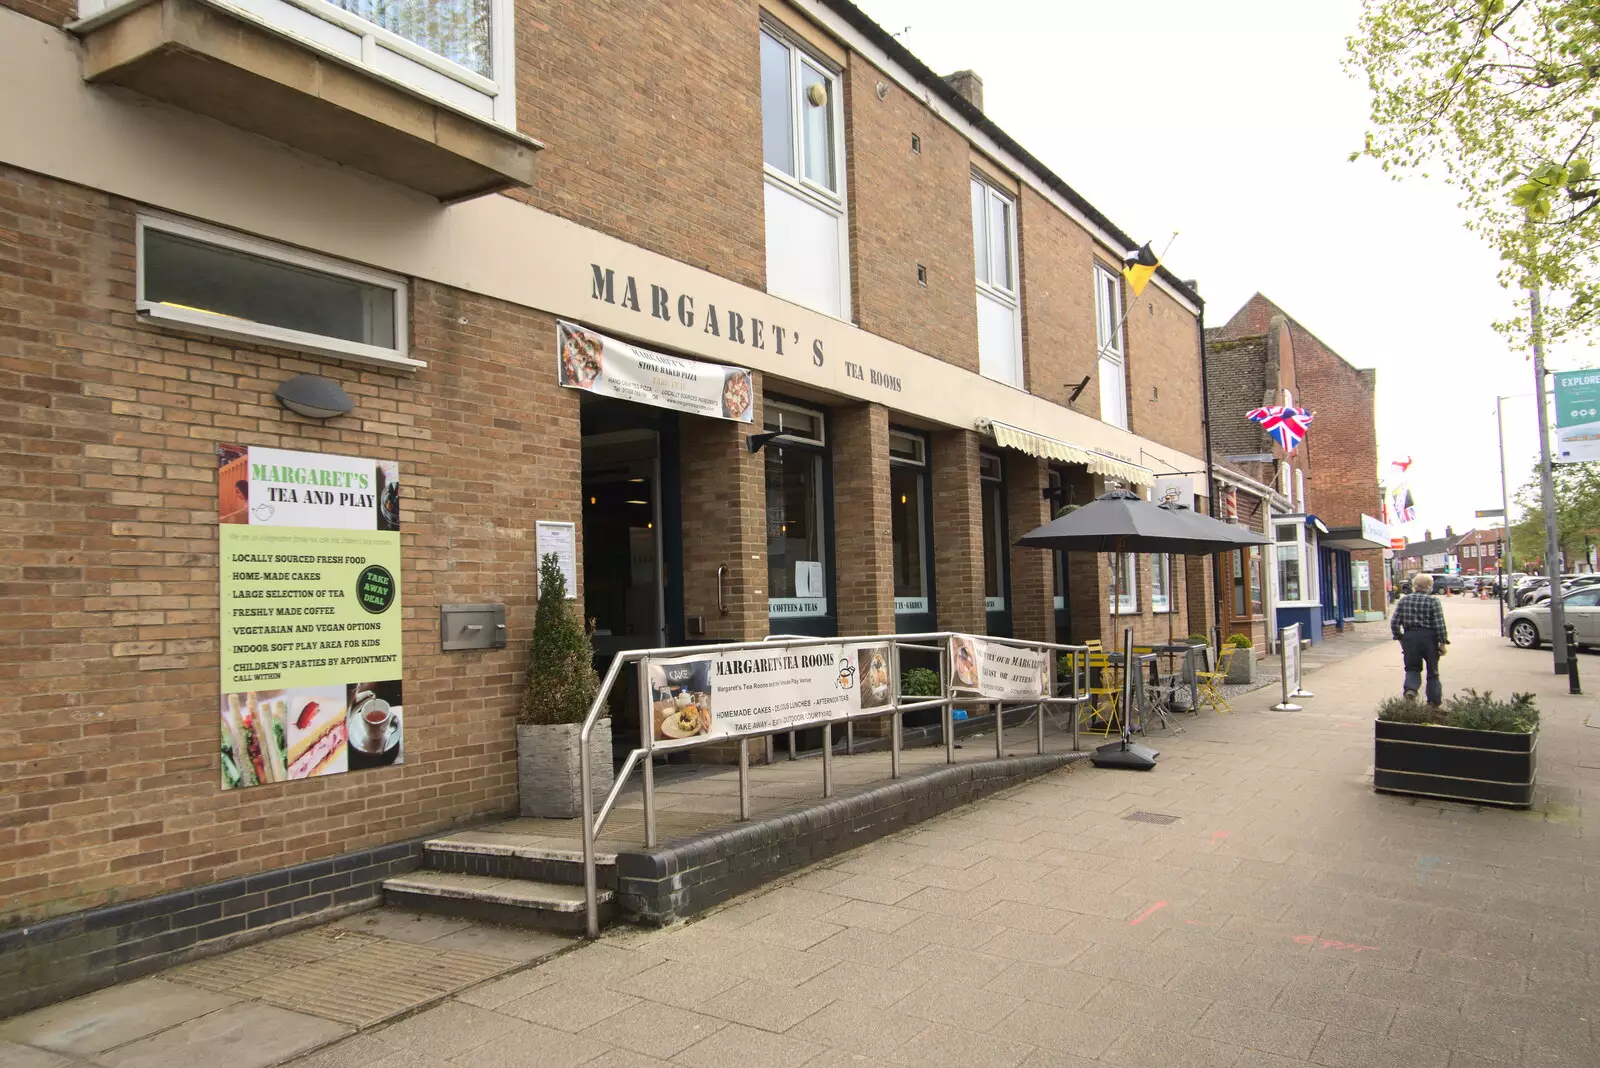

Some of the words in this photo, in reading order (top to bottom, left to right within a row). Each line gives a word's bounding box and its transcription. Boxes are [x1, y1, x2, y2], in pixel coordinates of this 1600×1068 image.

[590, 264, 824, 367] MARGARET'S
[844, 360, 864, 381] TEA
[870, 368, 902, 392] ROOMS
[638, 361, 659, 372] STONE
[660, 366, 681, 378] BAKED
[681, 372, 697, 381] PIZZA
[1562, 375, 1600, 388] EXPLORE
[252, 463, 369, 490] MARGARET'S
[268, 487, 298, 503] TEA
[303, 490, 334, 506] AND
[339, 492, 376, 508] PLAY
[232, 554, 274, 563] LOCALLY
[275, 555, 315, 564] SOURCED
[316, 556, 344, 564] FRESH
[345, 556, 366, 564] FOOD
[232, 572, 290, 580] HOME-MADE
[291, 572, 321, 580] CAKES
[366, 572, 389, 585] TAKE
[232, 590, 264, 598] LARGE
[265, 590, 314, 598] SELECTION
[316, 590, 326, 598] OF
[328, 590, 345, 598] TEA
[364, 582, 389, 595] AWAY
[364, 593, 385, 606] DEAL
[233, 608, 274, 616] FRESHLY
[276, 608, 302, 616] MADE
[304, 607, 335, 615] COFFEE
[772, 603, 798, 612] COFFEES
[799, 603, 803, 612] &
[804, 603, 818, 612] TEAS
[233, 625, 293, 635] VEGETARIAN
[295, 624, 314, 633] AND
[316, 623, 345, 632] VEGAN
[346, 622, 381, 631] OPTIONS
[233, 644, 269, 654] INDOOR
[271, 643, 294, 652] SOFT
[295, 641, 318, 651] PLAY
[319, 640, 343, 649] AREA
[344, 640, 360, 648] FOR
[361, 639, 380, 647] KIDS
[233, 661, 288, 672] CHILDREN'S
[289, 658, 326, 669] PARTIES
[328, 657, 339, 666] BY
[340, 654, 397, 665] APPOINTMENT
[783, 656, 799, 670] TEA
[801, 653, 834, 668] ROOMS
[254, 673, 281, 681] WITHIN
[669, 669, 689, 680] CAKE
[717, 684, 742, 693] Margaret's
[754, 681, 768, 689] Rooms
[716, 708, 752, 719] HOMEMADE
[753, 706, 772, 715] CAKES
[790, 700, 811, 709] LUNCHES
[816, 697, 838, 706] AFTERNOON
[839, 694, 849, 702] TEAS
[735, 722, 751, 731] TAKE
[752, 720, 767, 729] AWAY
